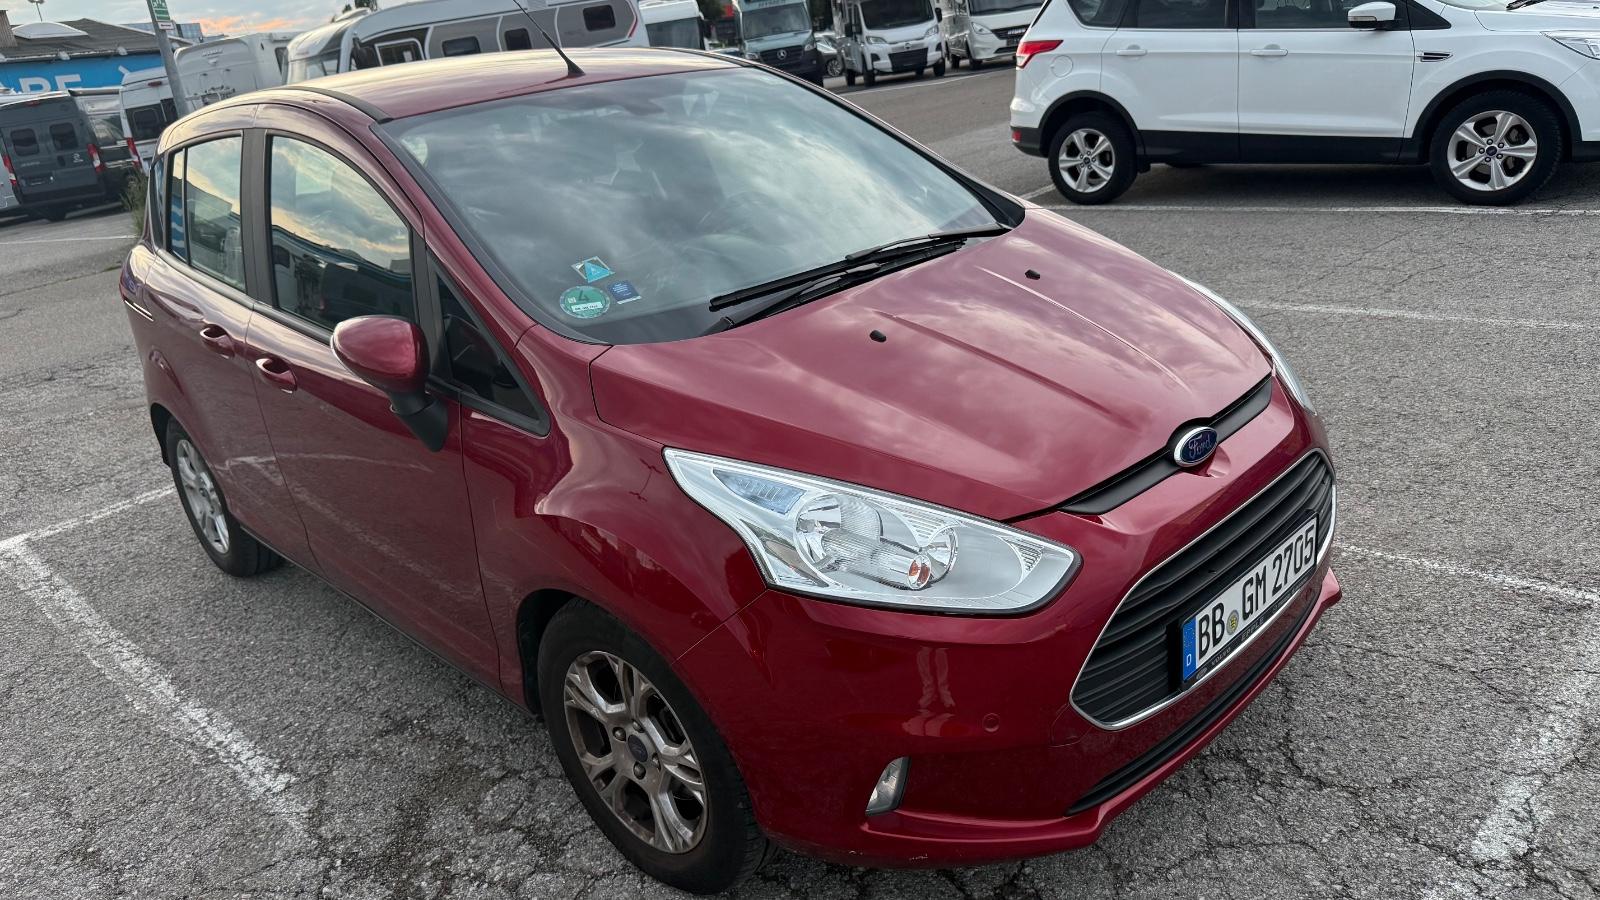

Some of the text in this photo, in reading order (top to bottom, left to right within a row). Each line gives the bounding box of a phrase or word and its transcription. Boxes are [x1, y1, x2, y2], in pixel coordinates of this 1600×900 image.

[1188, 434, 1213, 459] Ford
[1199, 602, 1225, 661] BB
[1242, 567, 1267, 618] GM
[1272, 525, 1315, 595] 2705
[1186, 653, 1192, 667] D
